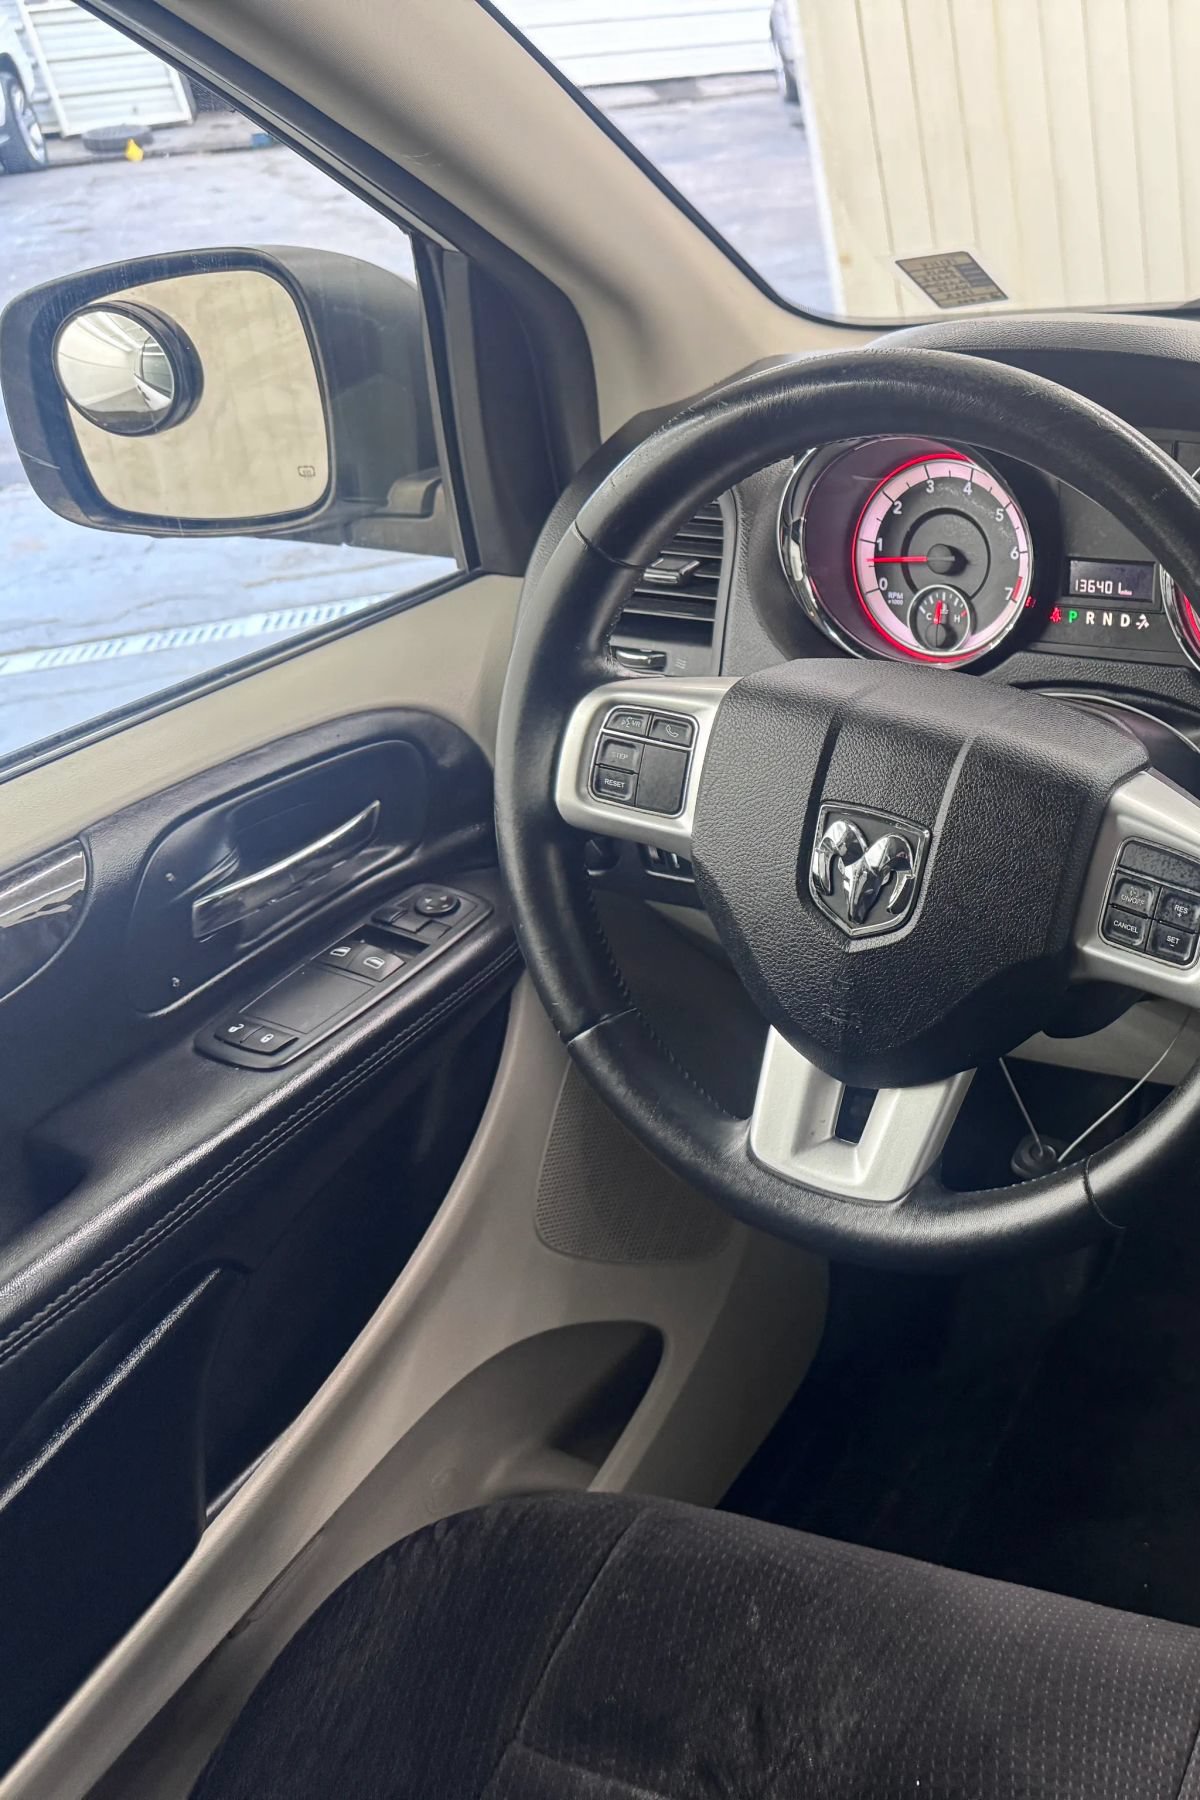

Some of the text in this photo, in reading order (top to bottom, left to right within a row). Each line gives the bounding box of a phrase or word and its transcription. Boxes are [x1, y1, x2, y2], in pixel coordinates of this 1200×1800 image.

[926, 480, 934, 493] 3
[963, 482, 972, 495] 4
[893, 502, 902, 514] 2
[996, 509, 1003, 521] 5
[876, 538, 882, 551] 1
[1010, 547, 1018, 559] 6
[879, 578, 888, 590] 0
[1005, 588, 1013, 600] 7
[954, 615, 960, 623] H
[1069, 611, 1130, 627] P R N D
[605, 778, 625, 788] RESET
[1174, 904, 1188, 914] RES
[1114, 920, 1138, 934] CANCEL
[1167, 936, 1180, 944] SET
